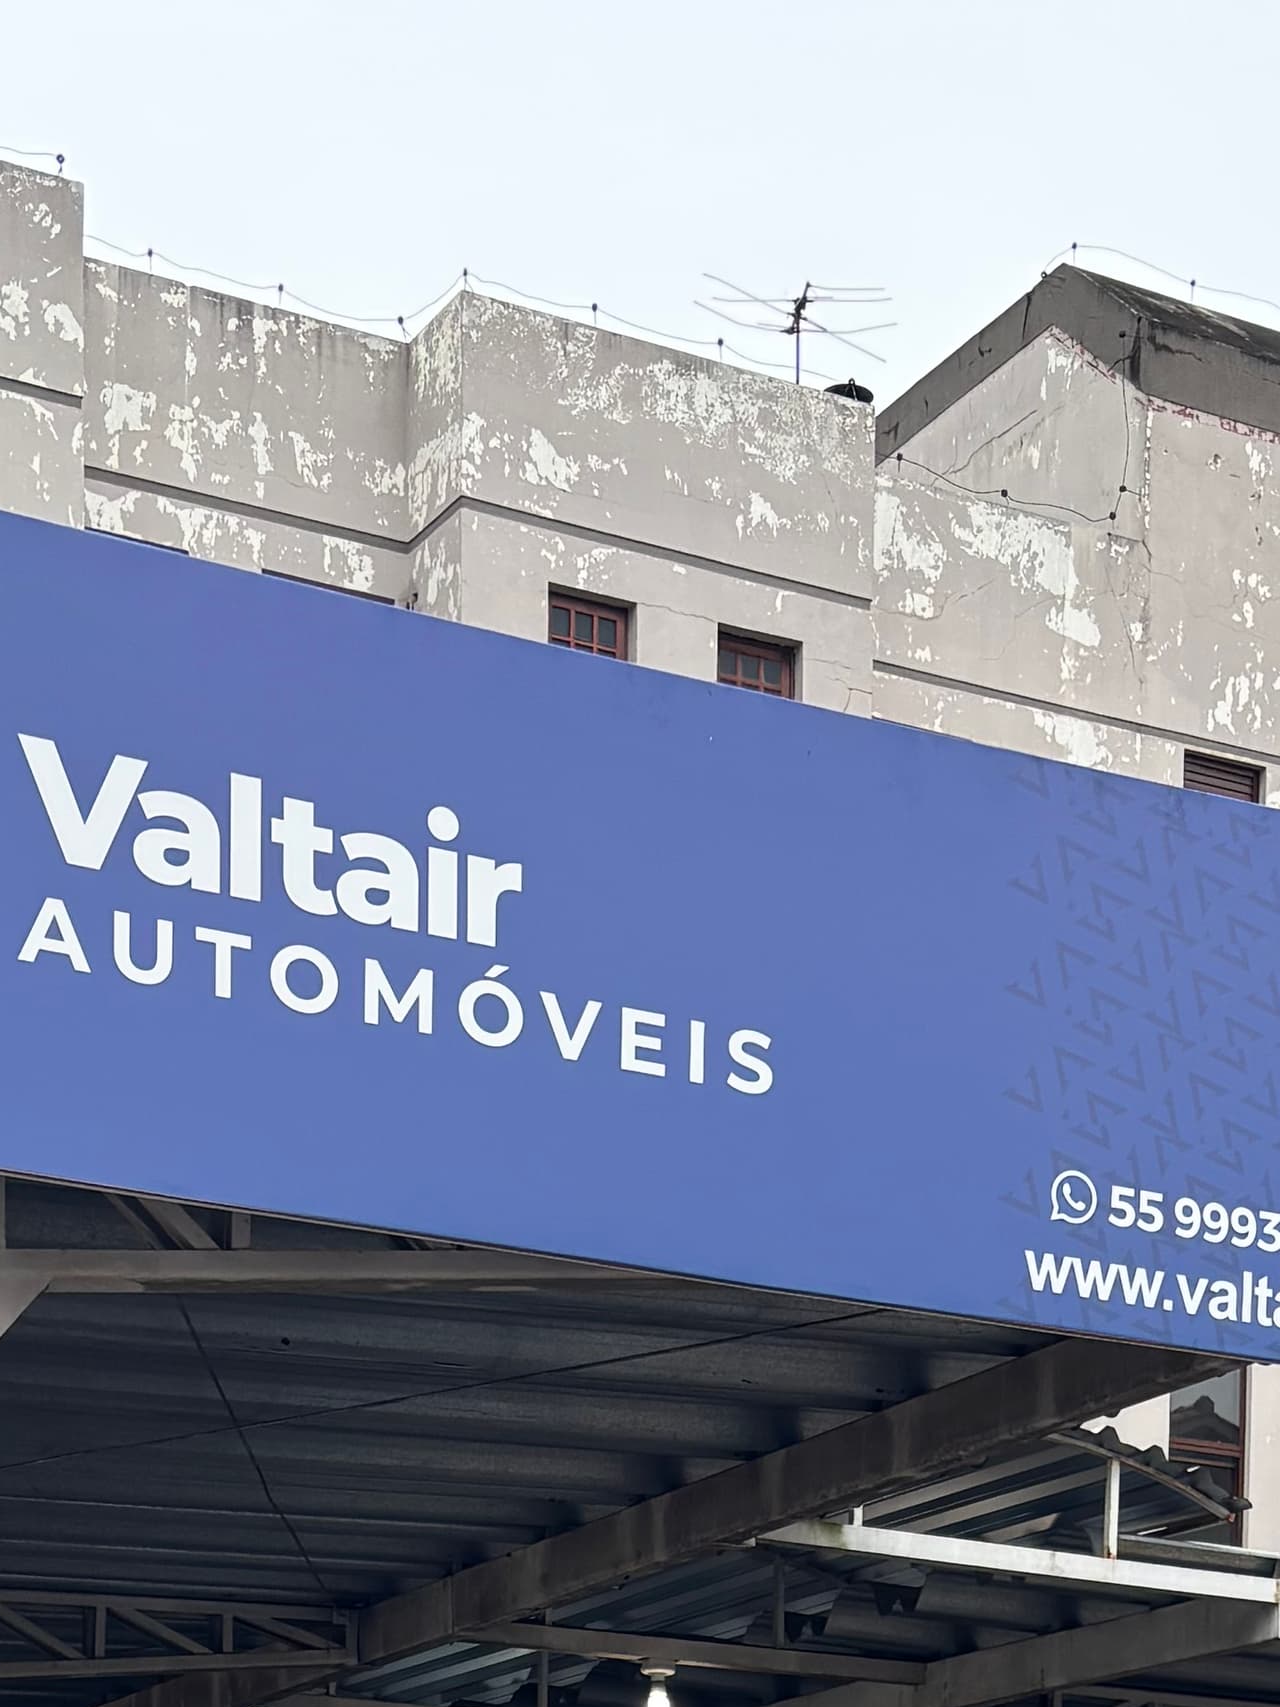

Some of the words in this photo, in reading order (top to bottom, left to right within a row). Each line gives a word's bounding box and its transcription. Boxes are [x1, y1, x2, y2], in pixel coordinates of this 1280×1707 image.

[17, 732, 523, 948] Valtair
[17, 897, 774, 1095] AUTOMÓVEIS
[1108, 1185, 1164, 1233] 55
